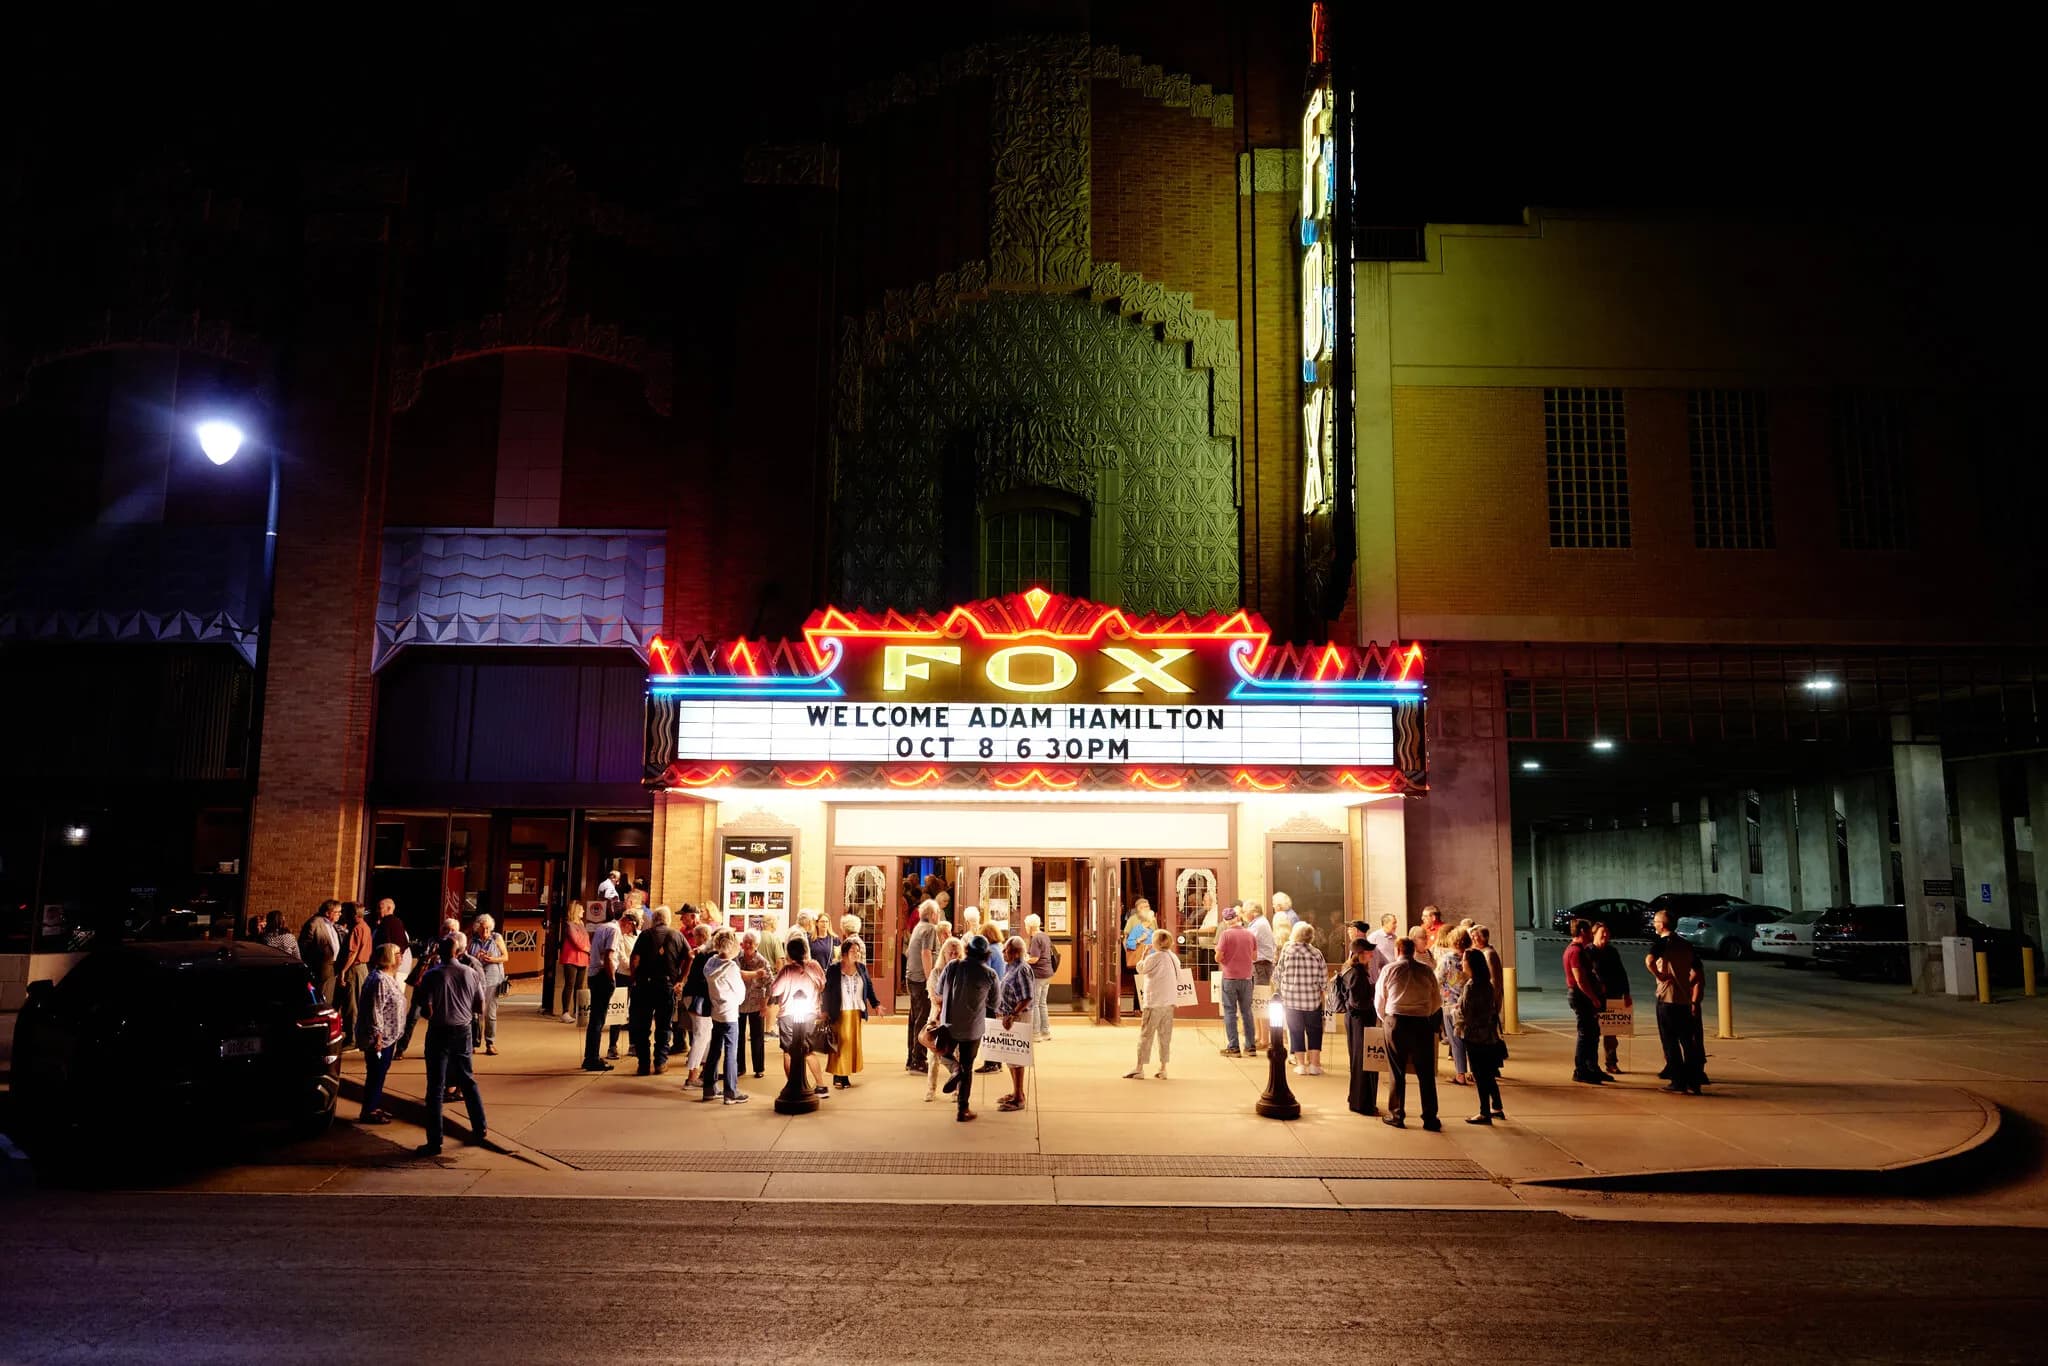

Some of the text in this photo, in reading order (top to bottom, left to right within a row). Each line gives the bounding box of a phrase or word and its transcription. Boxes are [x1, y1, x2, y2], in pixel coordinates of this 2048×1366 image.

[883, 645, 1196, 693] FOX
[806, 705, 1225, 730] WELCOME ADAM HAMILTON
[897, 736, 955, 758] OCT
[979, 737, 993, 758] 8
[505, 930, 536, 946] FOX
[983, 1035, 1030, 1049] HAMILTON
